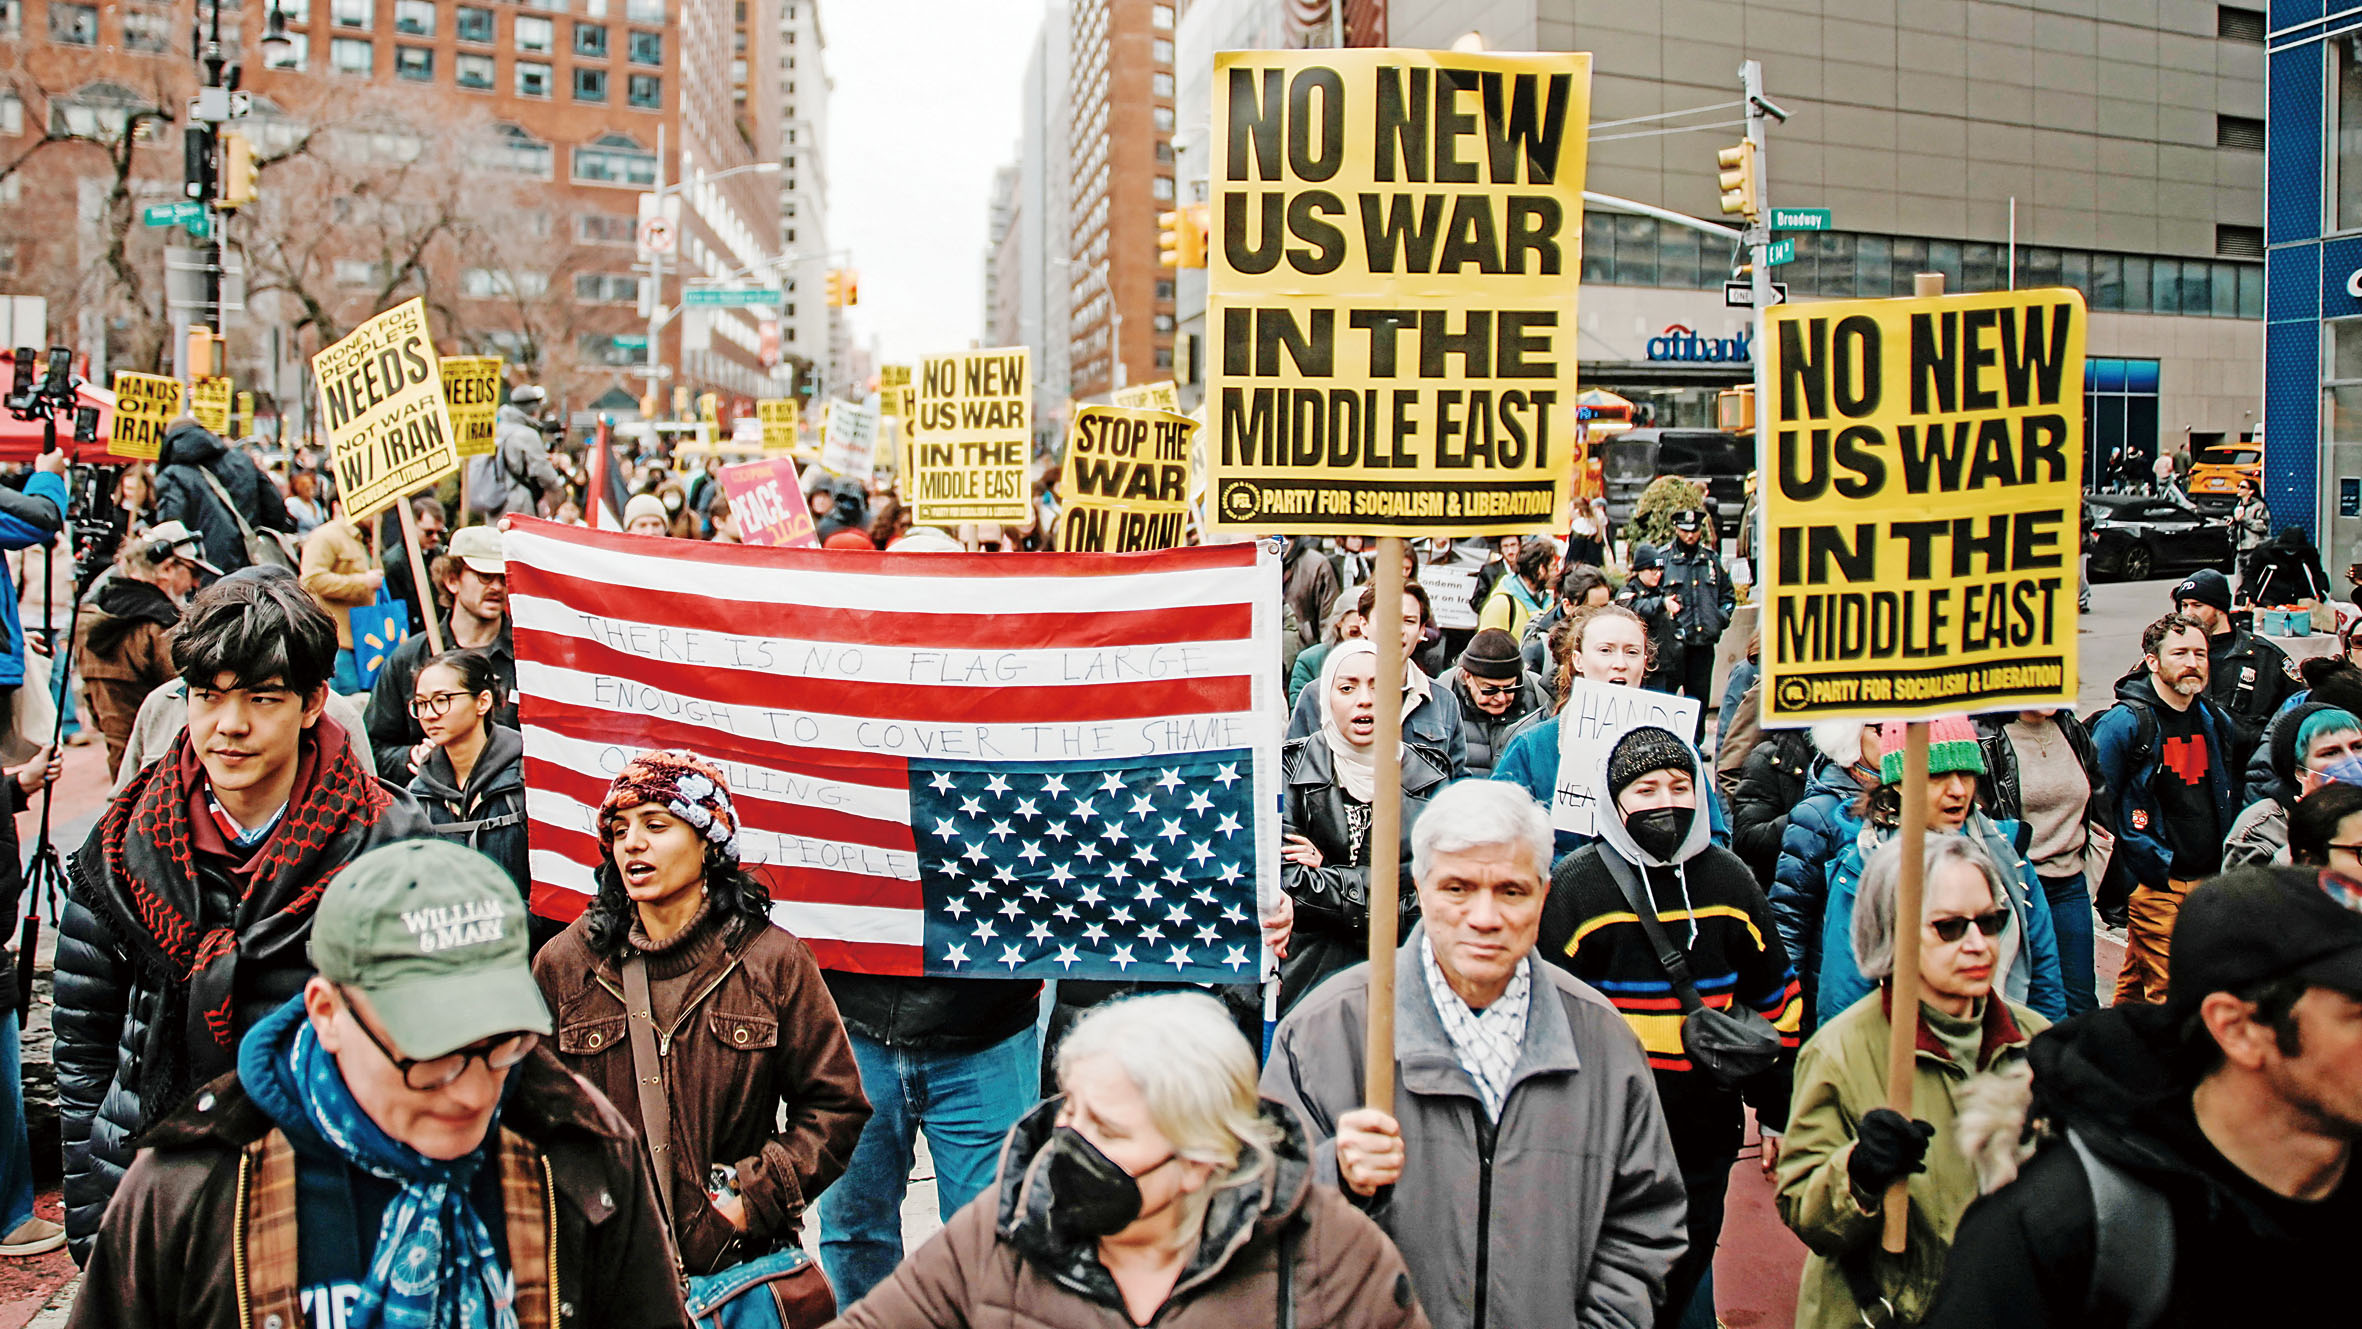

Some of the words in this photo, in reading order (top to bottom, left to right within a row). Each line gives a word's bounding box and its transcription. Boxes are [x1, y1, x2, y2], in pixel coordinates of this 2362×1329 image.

[1227, 66, 1345, 182] NO
[1374, 66, 1572, 184] NEW
[1224, 190, 1347, 276] US
[1358, 192, 1564, 275] WAR
[1777, 211, 1822, 229] Broadway
[1769, 247, 1774, 262] E
[1734, 290, 1749, 301] ONE
[318, 329, 371, 369] MONEY
[378, 306, 416, 331] FOR
[321, 319, 418, 384] PEOPLE'S
[1223, 308, 1334, 378] IN
[1350, 310, 1558, 379] THE
[1647, 329, 1751, 361] citibank
[326, 336, 428, 431] NEEDS
[922, 359, 956, 398] NO
[964, 355, 1024, 397] NEW
[1778, 314, 1884, 422] NO
[1910, 303, 2070, 414] NEW
[120, 378, 179, 401] HANDS
[444, 378, 495, 404] NEEDS
[1151, 389, 1171, 404] THE
[115, 416, 166, 444] IRAN
[336, 423, 376, 456] NOT
[380, 395, 435, 428] WAR
[466, 422, 492, 440] IRAN
[920, 401, 956, 430] US
[961, 401, 1024, 429] WAR
[1077, 414, 1148, 458] STOP
[1155, 421, 1192, 461] THE
[1221, 388, 1418, 468] MIDDLE
[1435, 389, 1557, 469] EAST
[340, 445, 373, 492] W/
[381, 410, 444, 469] IRAN
[920, 443, 954, 467] IN
[959, 441, 1023, 466] THE
[1778, 424, 1887, 502] US
[1898, 414, 2067, 494] WAR
[920, 471, 978, 500] MIDDLE
[985, 470, 1023, 498] EAST
[1074, 456, 1187, 501] WAR
[729, 480, 791, 538] PEACE
[1262, 489, 1316, 514] PARTY
[1319, 491, 1351, 515] FOR
[1355, 491, 1444, 517] SOCIALISM
[1447, 492, 1461, 516] &
[1464, 491, 1552, 517] LIBERATION
[1064, 507, 1110, 552] ON
[1778, 522, 1876, 585] IN
[1890, 509, 2063, 580] THE
[1423, 580, 1462, 590] ondemn
[1458, 596, 1470, 604] Ira
[1777, 588, 1948, 664] MIDDLE
[1962, 578, 2061, 652] EAST
[578, 615, 705, 663] THERE
[725, 638, 776, 668] IS
[803, 646, 863, 675] NO
[909, 652, 1027, 682] FLAG
[1063, 646, 1209, 681] LARGE
[1813, 680, 1860, 703] PARTY
[1861, 679, 1892, 700] FOR
[1895, 673, 1968, 699] SOCIALISM
[1969, 672, 1981, 691] &
[1982, 664, 2062, 690] LIBERATION
[595, 676, 734, 733] ENOUGH
[763, 711, 819, 742] TO
[857, 722, 1004, 757] COVER
[1021, 725, 1114, 756] THE
[1141, 717, 1247, 757] SHAME
[600, 747, 643, 774] O
[713, 762, 850, 805] LLING
[777, 833, 912, 880] PEOPLE
[401, 900, 505, 933] WILLIAM
